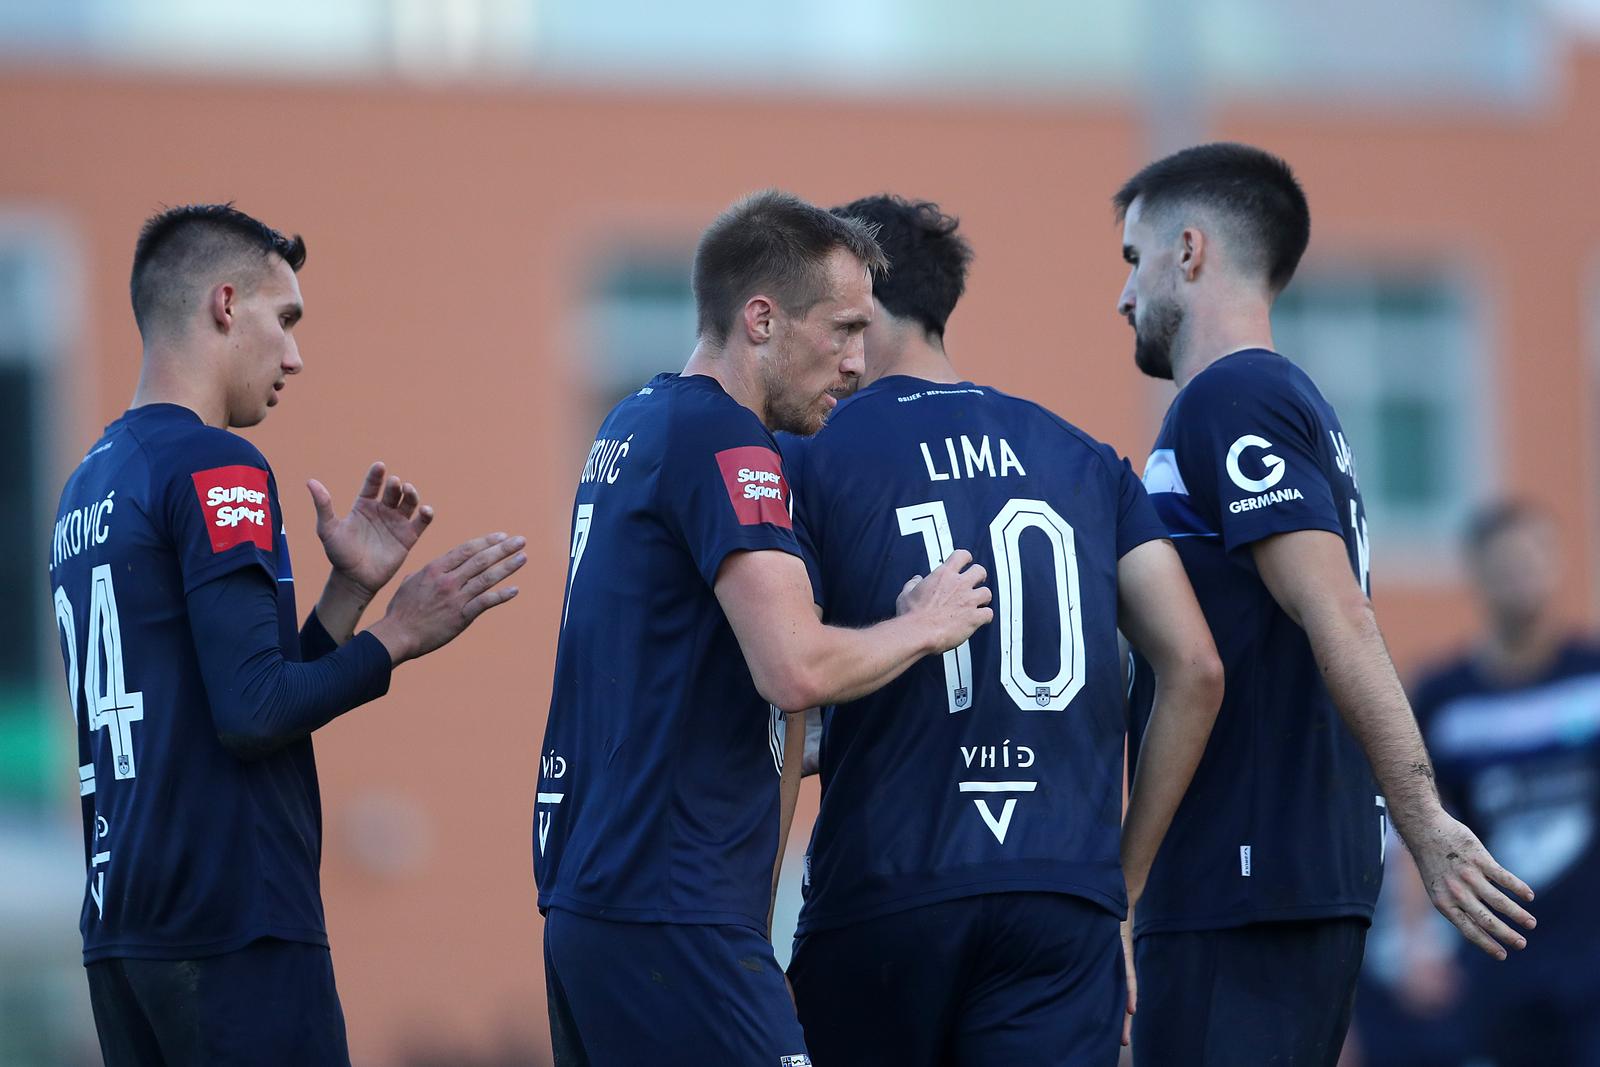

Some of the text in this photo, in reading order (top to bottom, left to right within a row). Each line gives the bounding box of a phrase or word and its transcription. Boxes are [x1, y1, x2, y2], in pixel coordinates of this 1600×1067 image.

[919, 434, 1026, 481] LIMA
[737, 468, 781, 484] Super
[206, 486, 266, 506] Super
[1229, 488, 1304, 514] GERMANIA
[215, 506, 266, 527] Sport
[895, 498, 1086, 714] 10
[960, 739, 1035, 768] VHÍD
